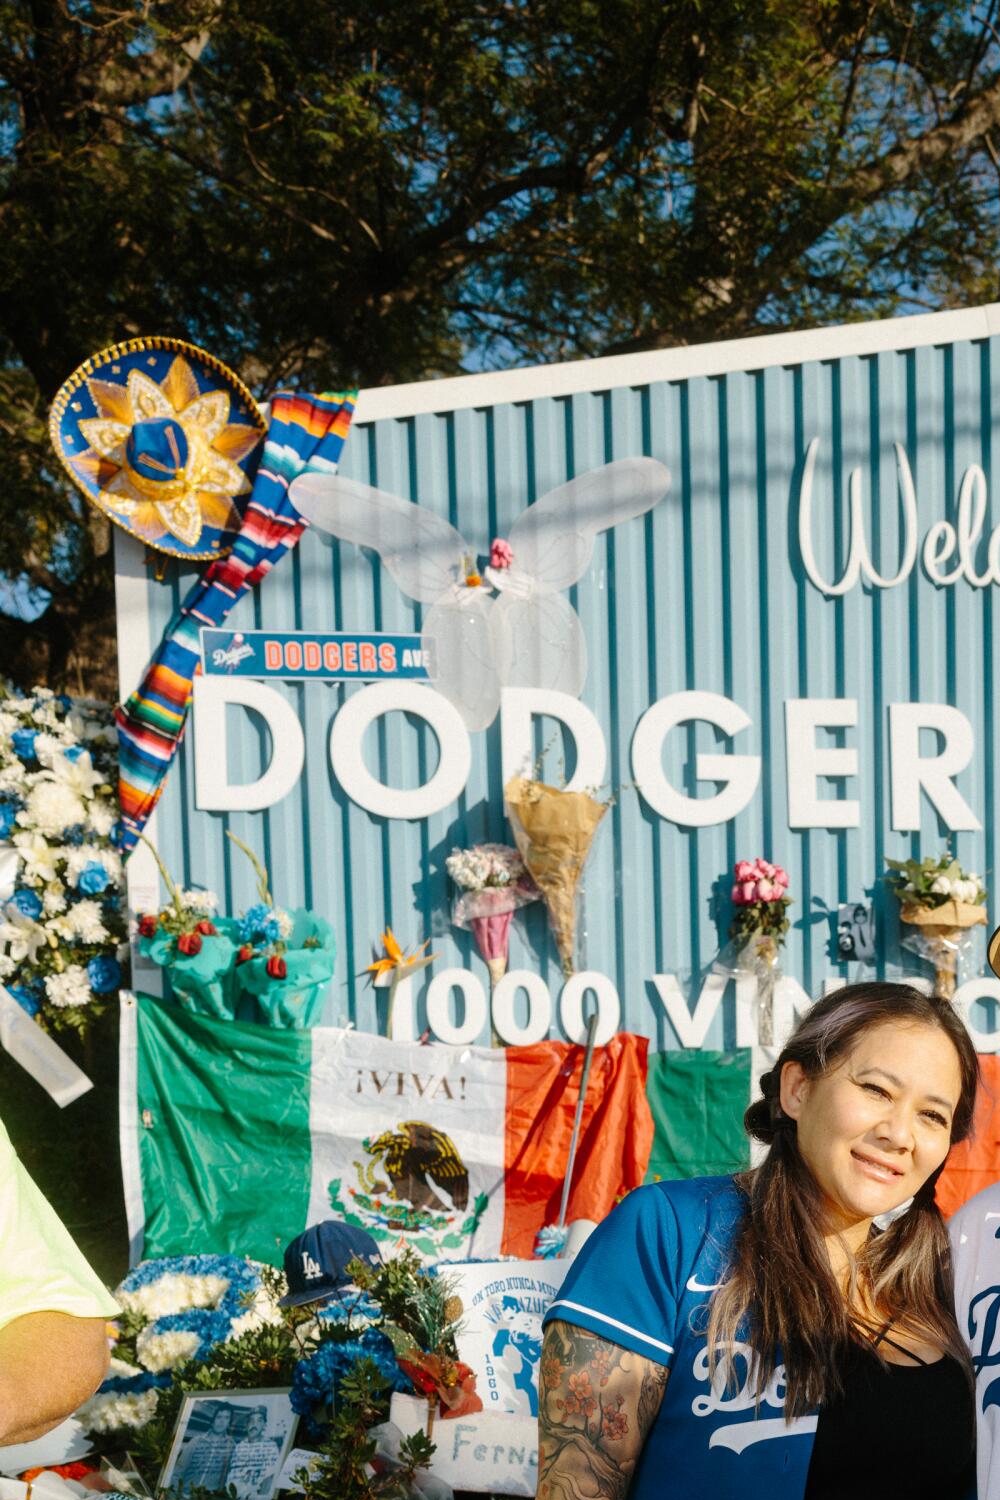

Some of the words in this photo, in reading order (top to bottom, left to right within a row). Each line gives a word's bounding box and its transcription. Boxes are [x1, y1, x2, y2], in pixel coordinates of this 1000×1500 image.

[264, 640, 398, 672] DODGERS
[402, 649, 431, 668] AVE
[195, 676, 983, 831] DODGER
[374, 965, 621, 1049] 1000
[355, 1069, 468, 1101] ¡VIVA!
[302, 1251, 323, 1279] LA
[484, 1281, 507, 1298] TORO
[505, 1276, 537, 1291] NUNCA
[484, 1353, 500, 1403] 1960
